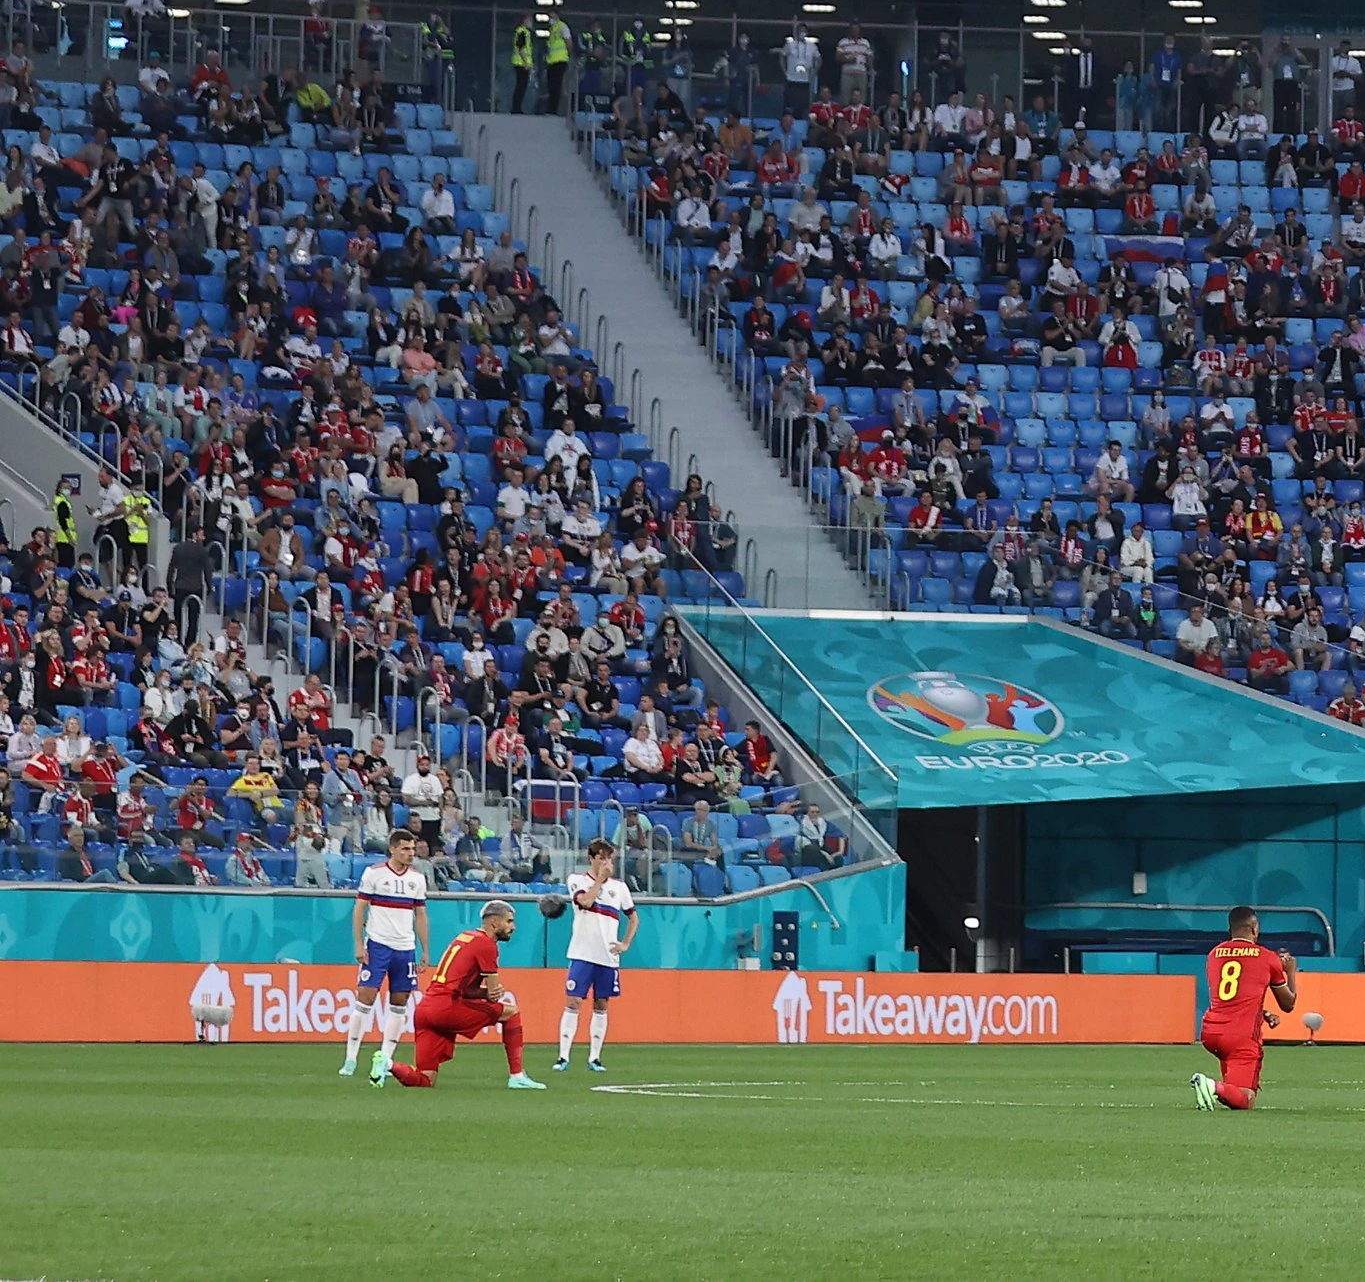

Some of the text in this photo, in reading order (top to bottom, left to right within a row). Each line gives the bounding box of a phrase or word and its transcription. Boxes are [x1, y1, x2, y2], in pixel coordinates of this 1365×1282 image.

[966, 739, 1040, 756] UEFA
[914, 749, 1130, 769] EURO2020
[394, 879, 406, 895] 11
[1215, 947, 1261, 958] TIELEMANS
[432, 945, 462, 984] 11
[1218, 959, 1242, 1001] 8
[817, 976, 1059, 1044] Takeaway.com
